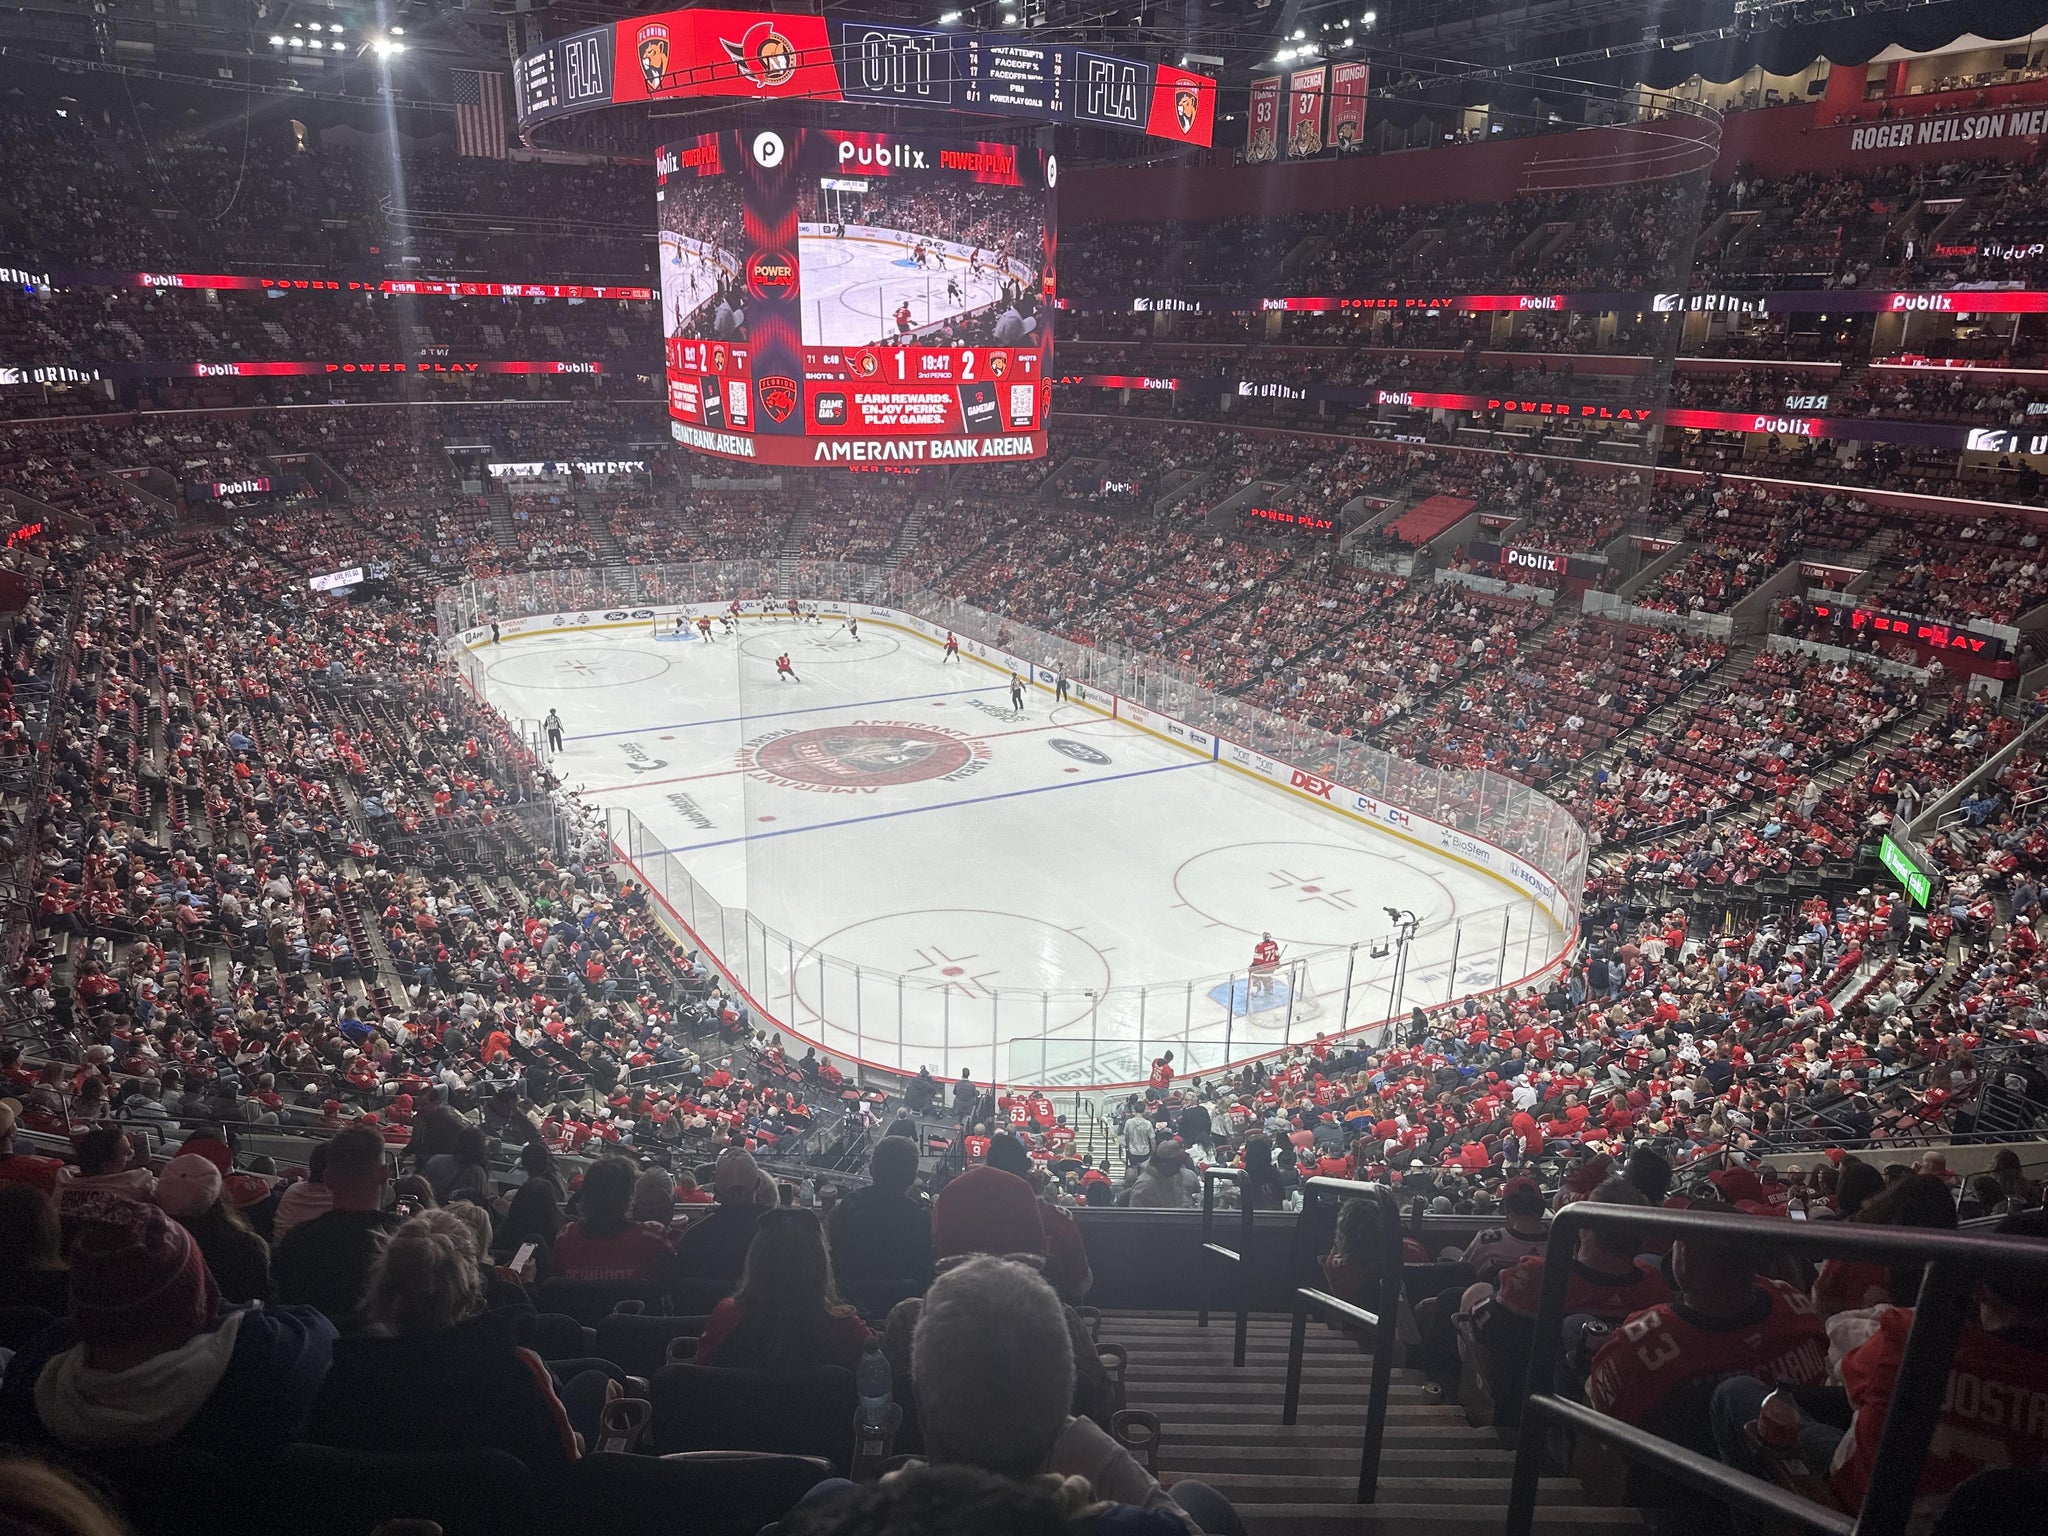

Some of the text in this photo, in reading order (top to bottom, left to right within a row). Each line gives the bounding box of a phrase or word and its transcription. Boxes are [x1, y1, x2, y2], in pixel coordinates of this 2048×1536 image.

[1009, 47, 1044, 59] ATTEMPTS
[565, 38, 603, 99] FLA
[862, 32, 935, 94] OTT
[969, 66, 979, 77] 17
[995, 57, 1032, 70] FACEOFF
[1032, 63, 1039, 71] %
[1335, 65, 1366, 83] LUONGO
[1009, 84, 1025, 93] PIM
[1088, 60, 1137, 120] FLA
[1344, 83, 1352, 105] 1
[1024, 98, 1043, 108] GOALS
[1256, 101, 1272, 123] 93
[1299, 93, 1315, 115] 37
[1851, 124, 1914, 151] ROGER
[1917, 114, 2005, 145] NEILSON
[681, 148, 701, 169] POWER
[700, 144, 718, 166] PLAY
[940, 150, 984, 172] POWER
[984, 154, 1014, 175] PLAY
[754, 265, 792, 277] POWER
[143, 274, 340, 290] Publix POWER
[752, 276, 796, 286] PLAY
[554, 286, 560, 297] 2
[1262, 294, 1953, 311] Publix POWER PLAY Publix Publix
[699, 343, 708, 372] 2
[806, 355, 816, 364] 71
[894, 350, 906, 380] 1
[961, 350, 975, 380] 2
[199, 362, 596, 376] Publix POWER PLAY Publix
[819, 400, 844, 409] GAME
[854, 393, 953, 404] EARN REWARDS.
[1143, 379, 1813, 436] Publix Publix POWER PLAY Publix
[861, 404, 947, 414] ENJOY PERKS.
[864, 414, 945, 424] PLAY GAMES.
[694, 428, 756, 458] BANK ARENA
[814, 436, 1034, 462] AMERANT BANK ARENA
[1251, 507, 1333, 529] POWER PLAY
[501, 618, 528, 629] AMERANT
[472, 632, 484, 641] App
[1918, 627, 1986, 652] PLAY
[852, 719, 970, 737] AMERANT
[936, 759, 988, 782] ARENA
[747, 772, 880, 794] AMERANT
[1290, 769, 1336, 801] DEX
[1358, 796, 1377, 814] CH
[1389, 809, 1409, 826] CH
[1452, 836, 1490, 860] BioStem
[1264, 948, 1277, 962] 72
[1290, 1073, 1304, 1085] 72
[1010, 1109, 1026, 1122] 63
[1040, 1104, 1049, 1116] 5
[972, 1145, 981, 1157] 9
[1624, 1309, 1681, 1372] 63
